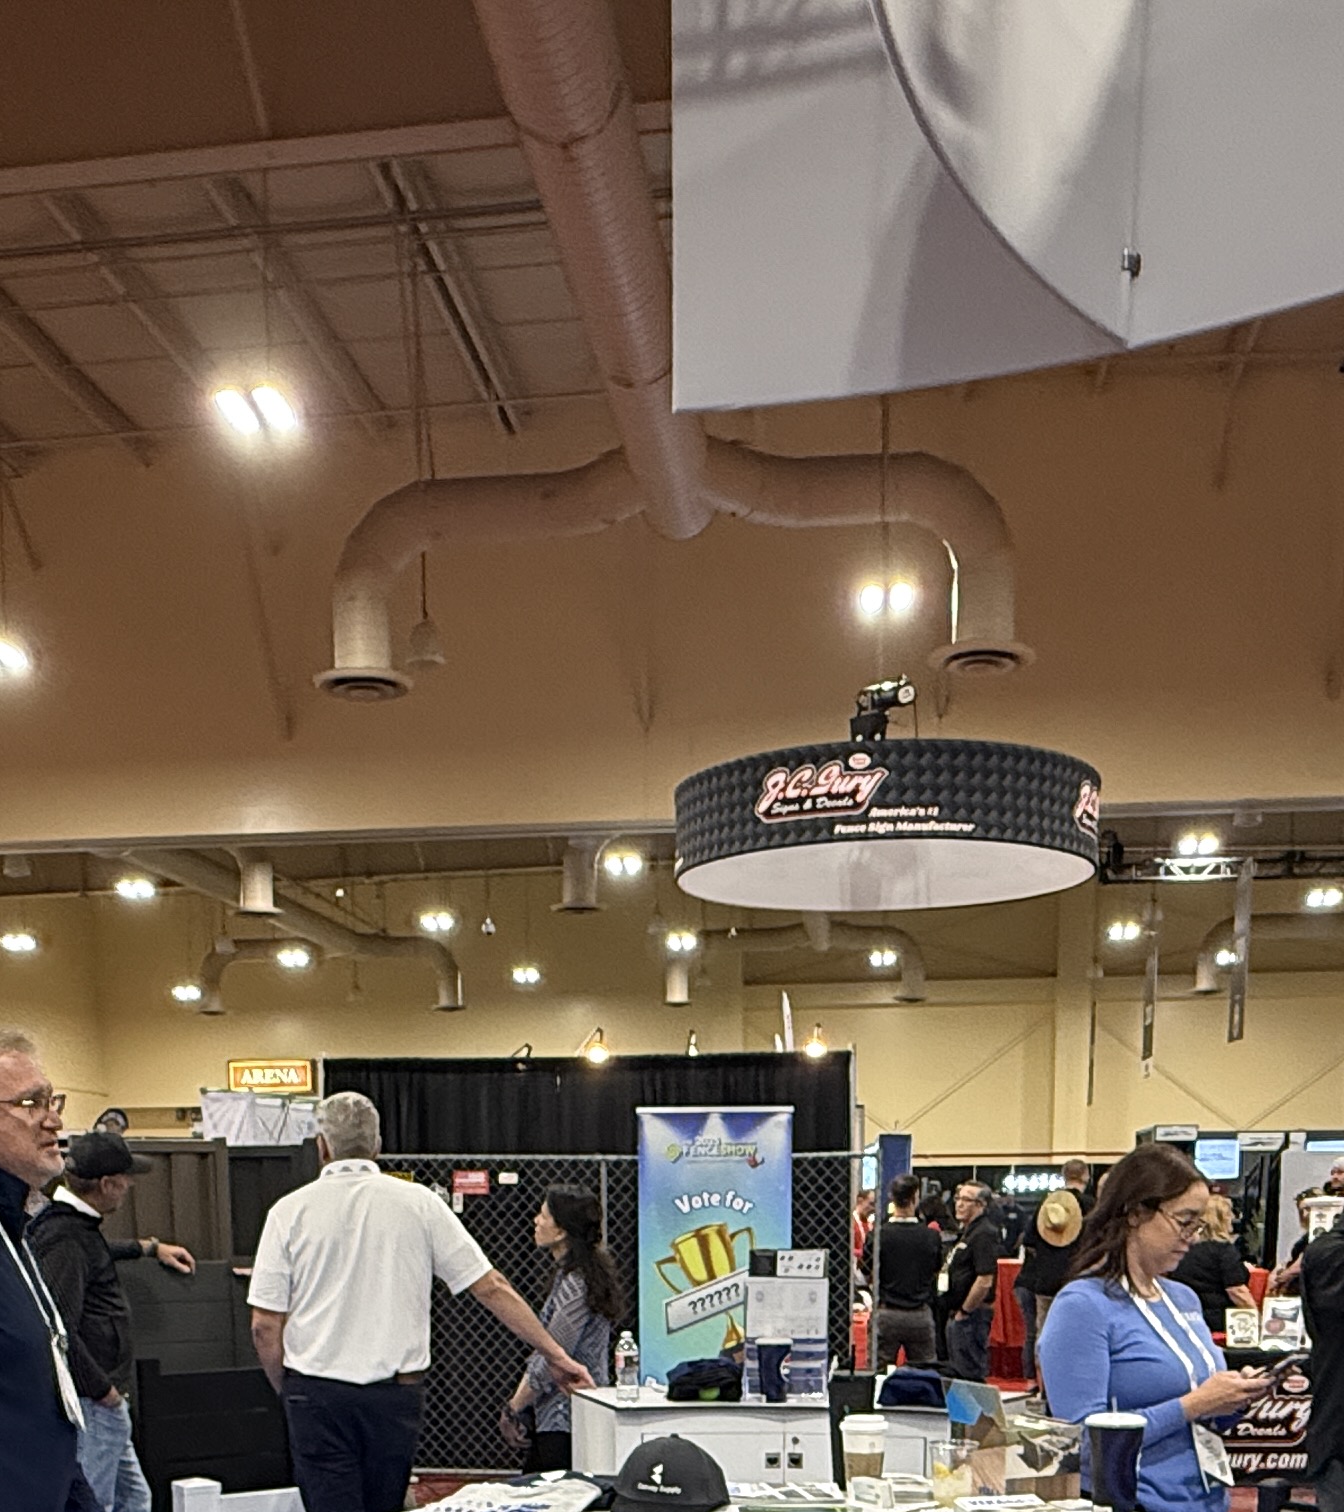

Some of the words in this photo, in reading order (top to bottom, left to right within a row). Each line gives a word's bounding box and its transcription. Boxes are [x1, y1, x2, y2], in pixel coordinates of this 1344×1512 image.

[868, 805, 926, 818] America's
[834, 823, 867, 835] Fence
[867, 822, 894, 835] Sign
[895, 820, 976, 833] Manufacturer
[240, 1068, 301, 1085] ARENA
[674, 1191, 721, 1214] Vote
[724, 1190, 754, 1214] for
[1236, 1422, 1288, 1436] Decals
